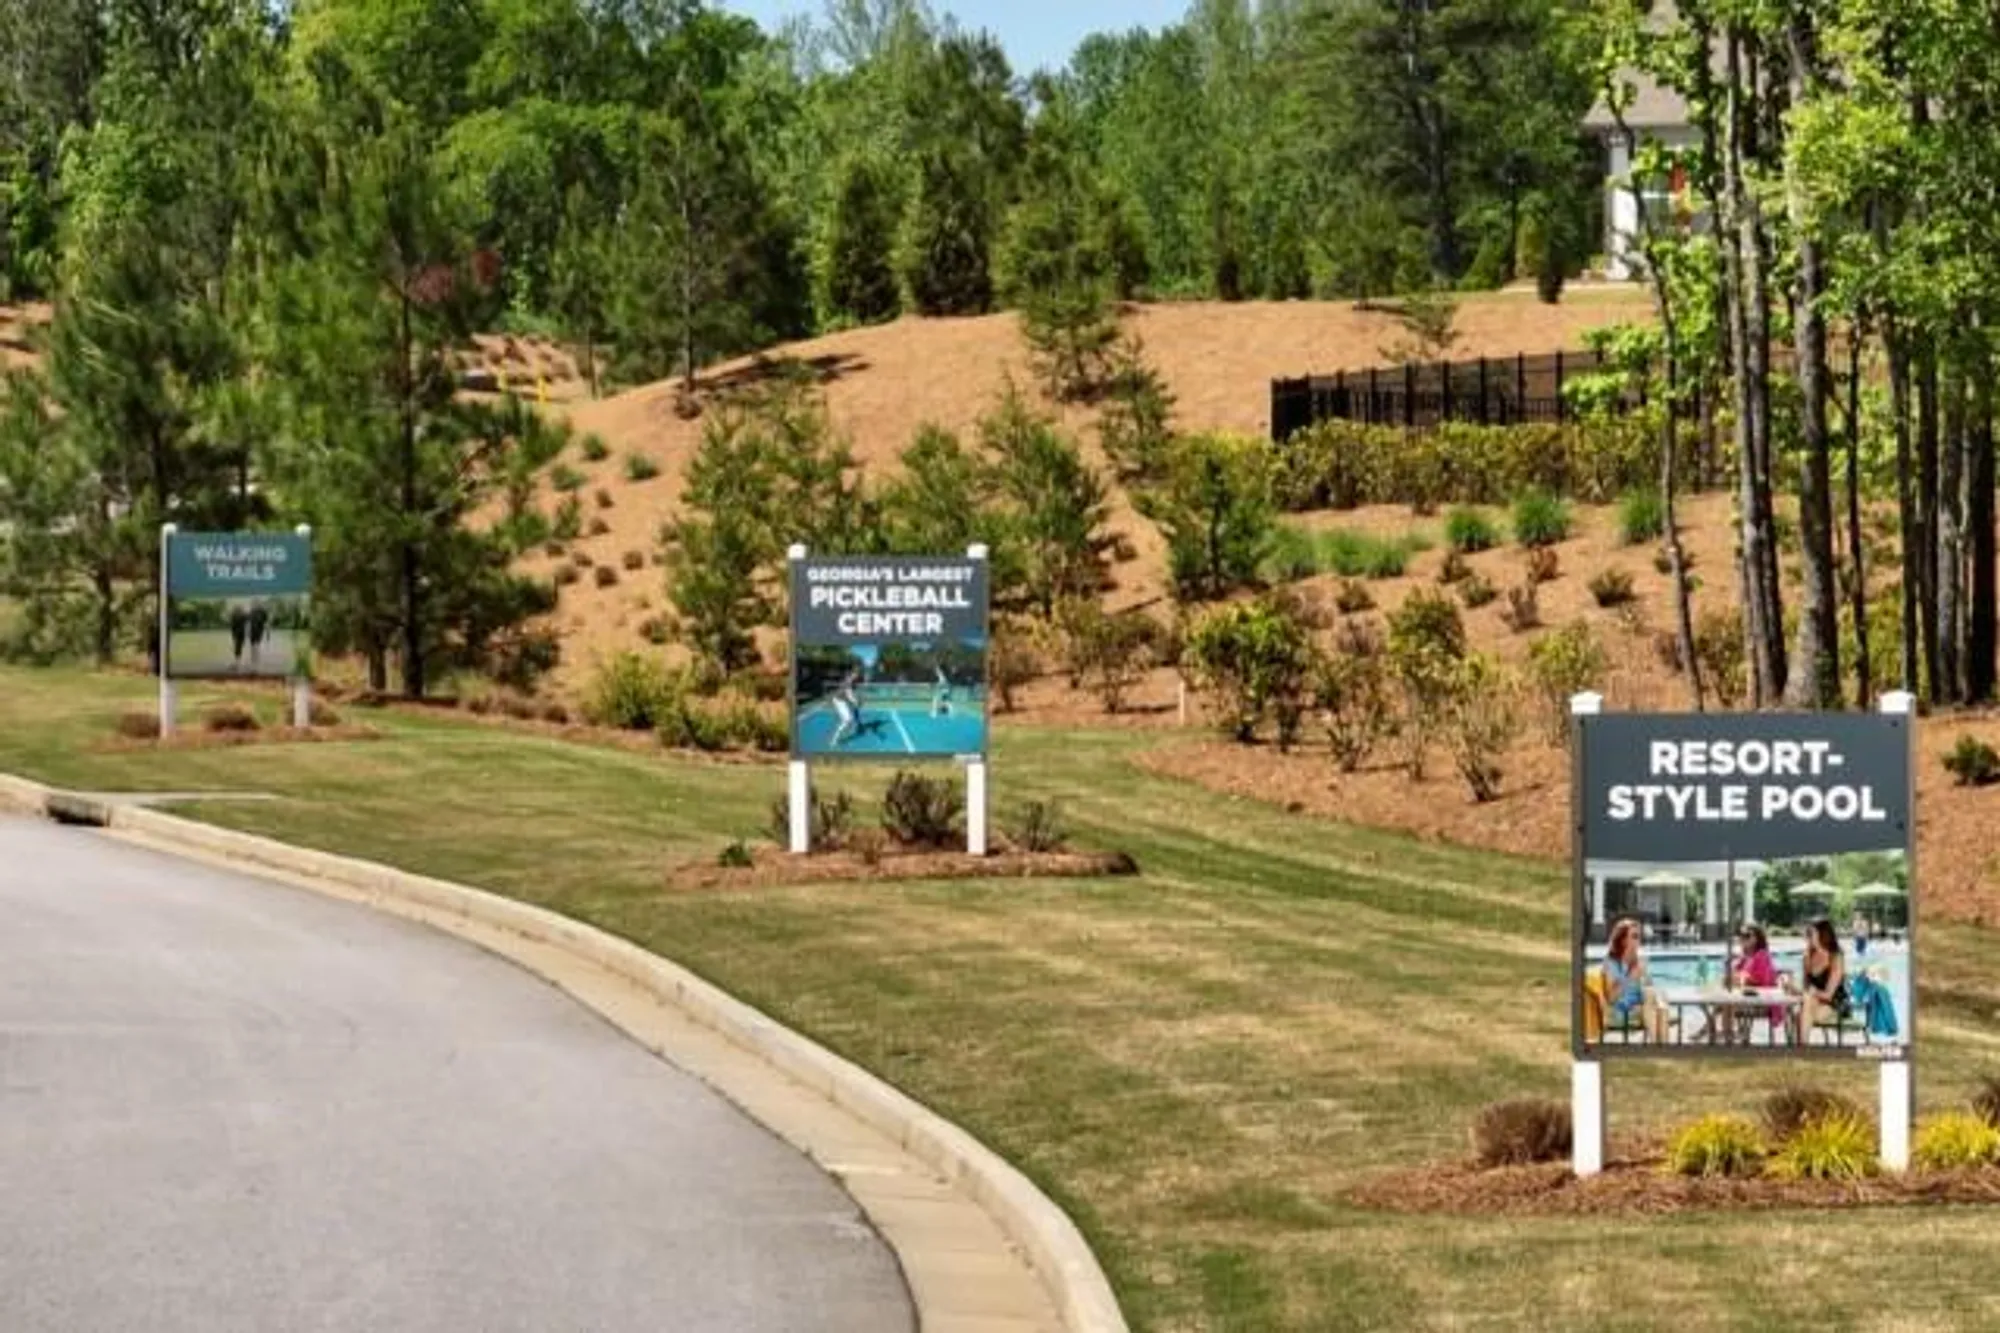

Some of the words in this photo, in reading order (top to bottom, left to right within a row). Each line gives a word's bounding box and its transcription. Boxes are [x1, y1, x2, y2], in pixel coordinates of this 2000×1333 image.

[194, 545, 287, 562] WALKING
[207, 563, 276, 580] TRAILS
[807, 567, 893, 581] GEORGIA'S
[899, 567, 973, 581] LARGEST
[810, 585, 971, 608] PICKLEBALL
[838, 613, 943, 634] CENTER
[1650, 741, 1844, 775] RESORT-
[1608, 785, 1749, 819] STYLE
[1761, 785, 1886, 819] POOL
